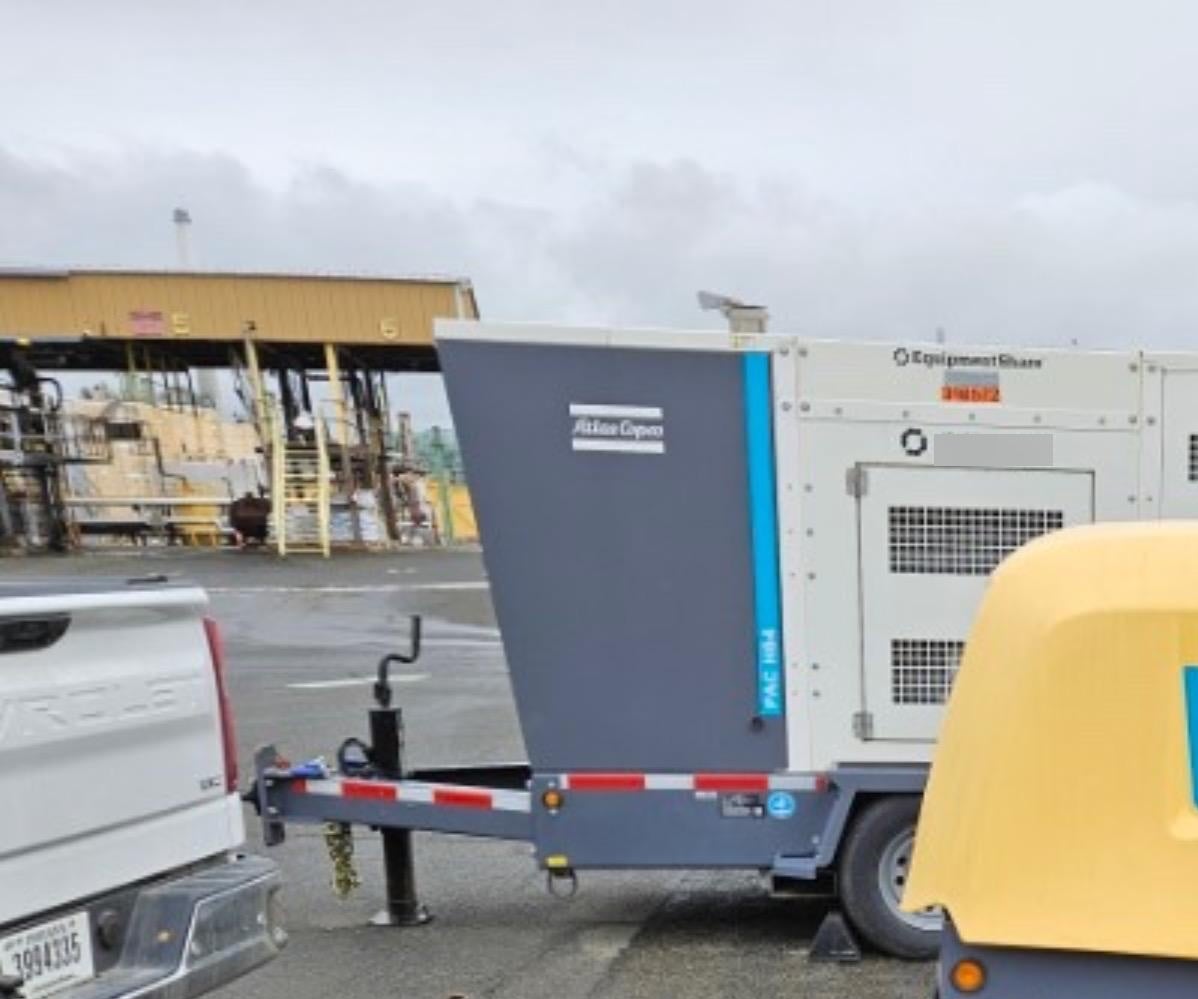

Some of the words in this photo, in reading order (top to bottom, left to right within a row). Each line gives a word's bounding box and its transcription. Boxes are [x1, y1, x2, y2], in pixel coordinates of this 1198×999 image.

[911, 350, 1042, 369] EquipmentShare
[573, 418, 618, 436] Atlas
[620, 419, 664, 440] Copco
